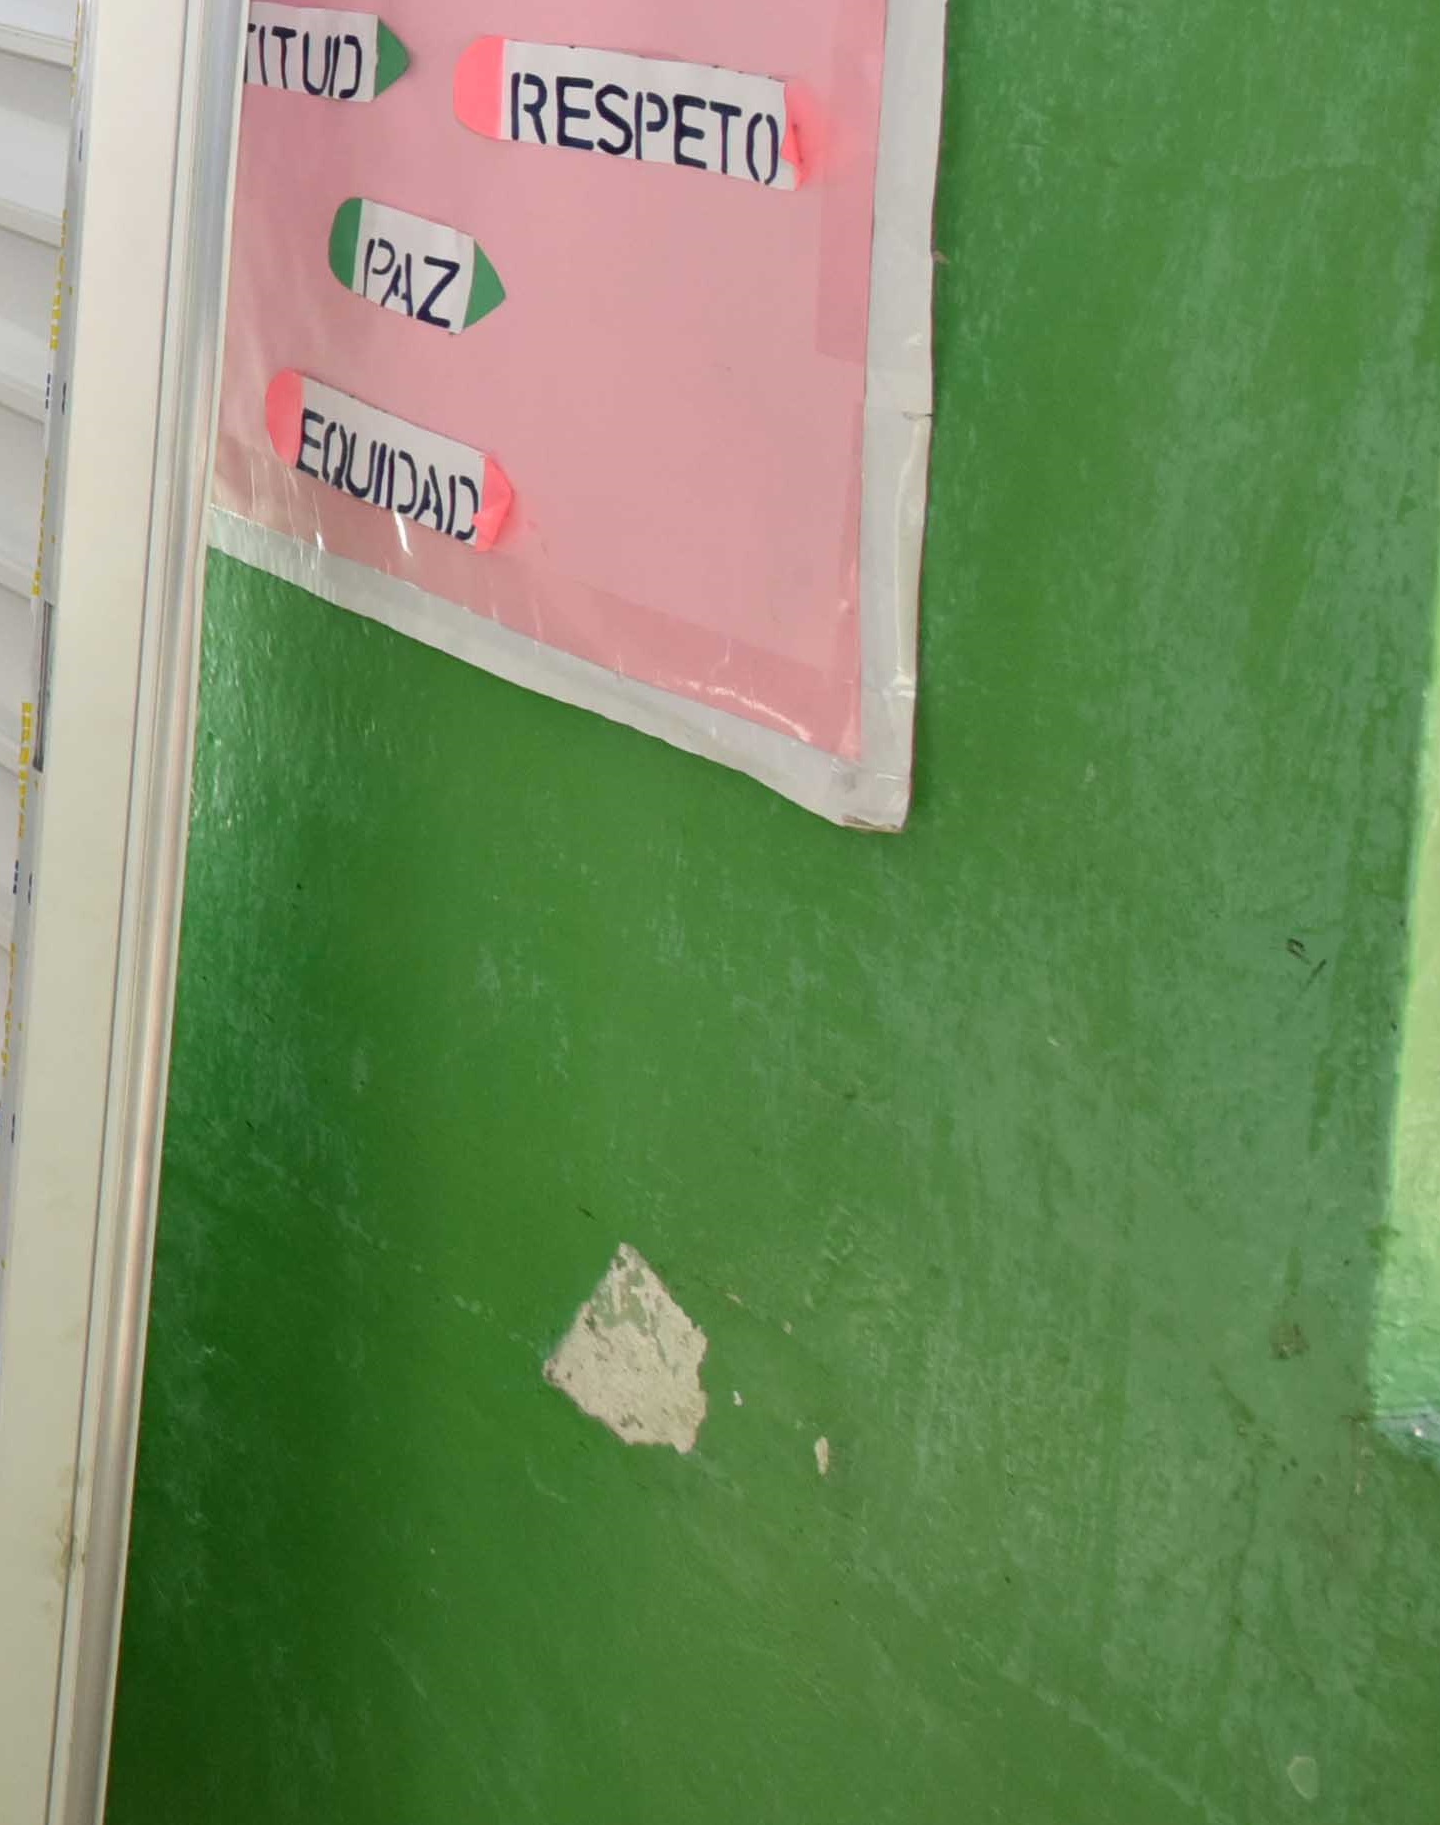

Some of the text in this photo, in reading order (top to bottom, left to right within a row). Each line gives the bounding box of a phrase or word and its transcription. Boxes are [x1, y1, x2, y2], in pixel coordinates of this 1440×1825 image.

[510, 71, 780, 186] RESPETO
[362, 237, 461, 329] PAZ
[295, 406, 480, 542] EQUIDAD
